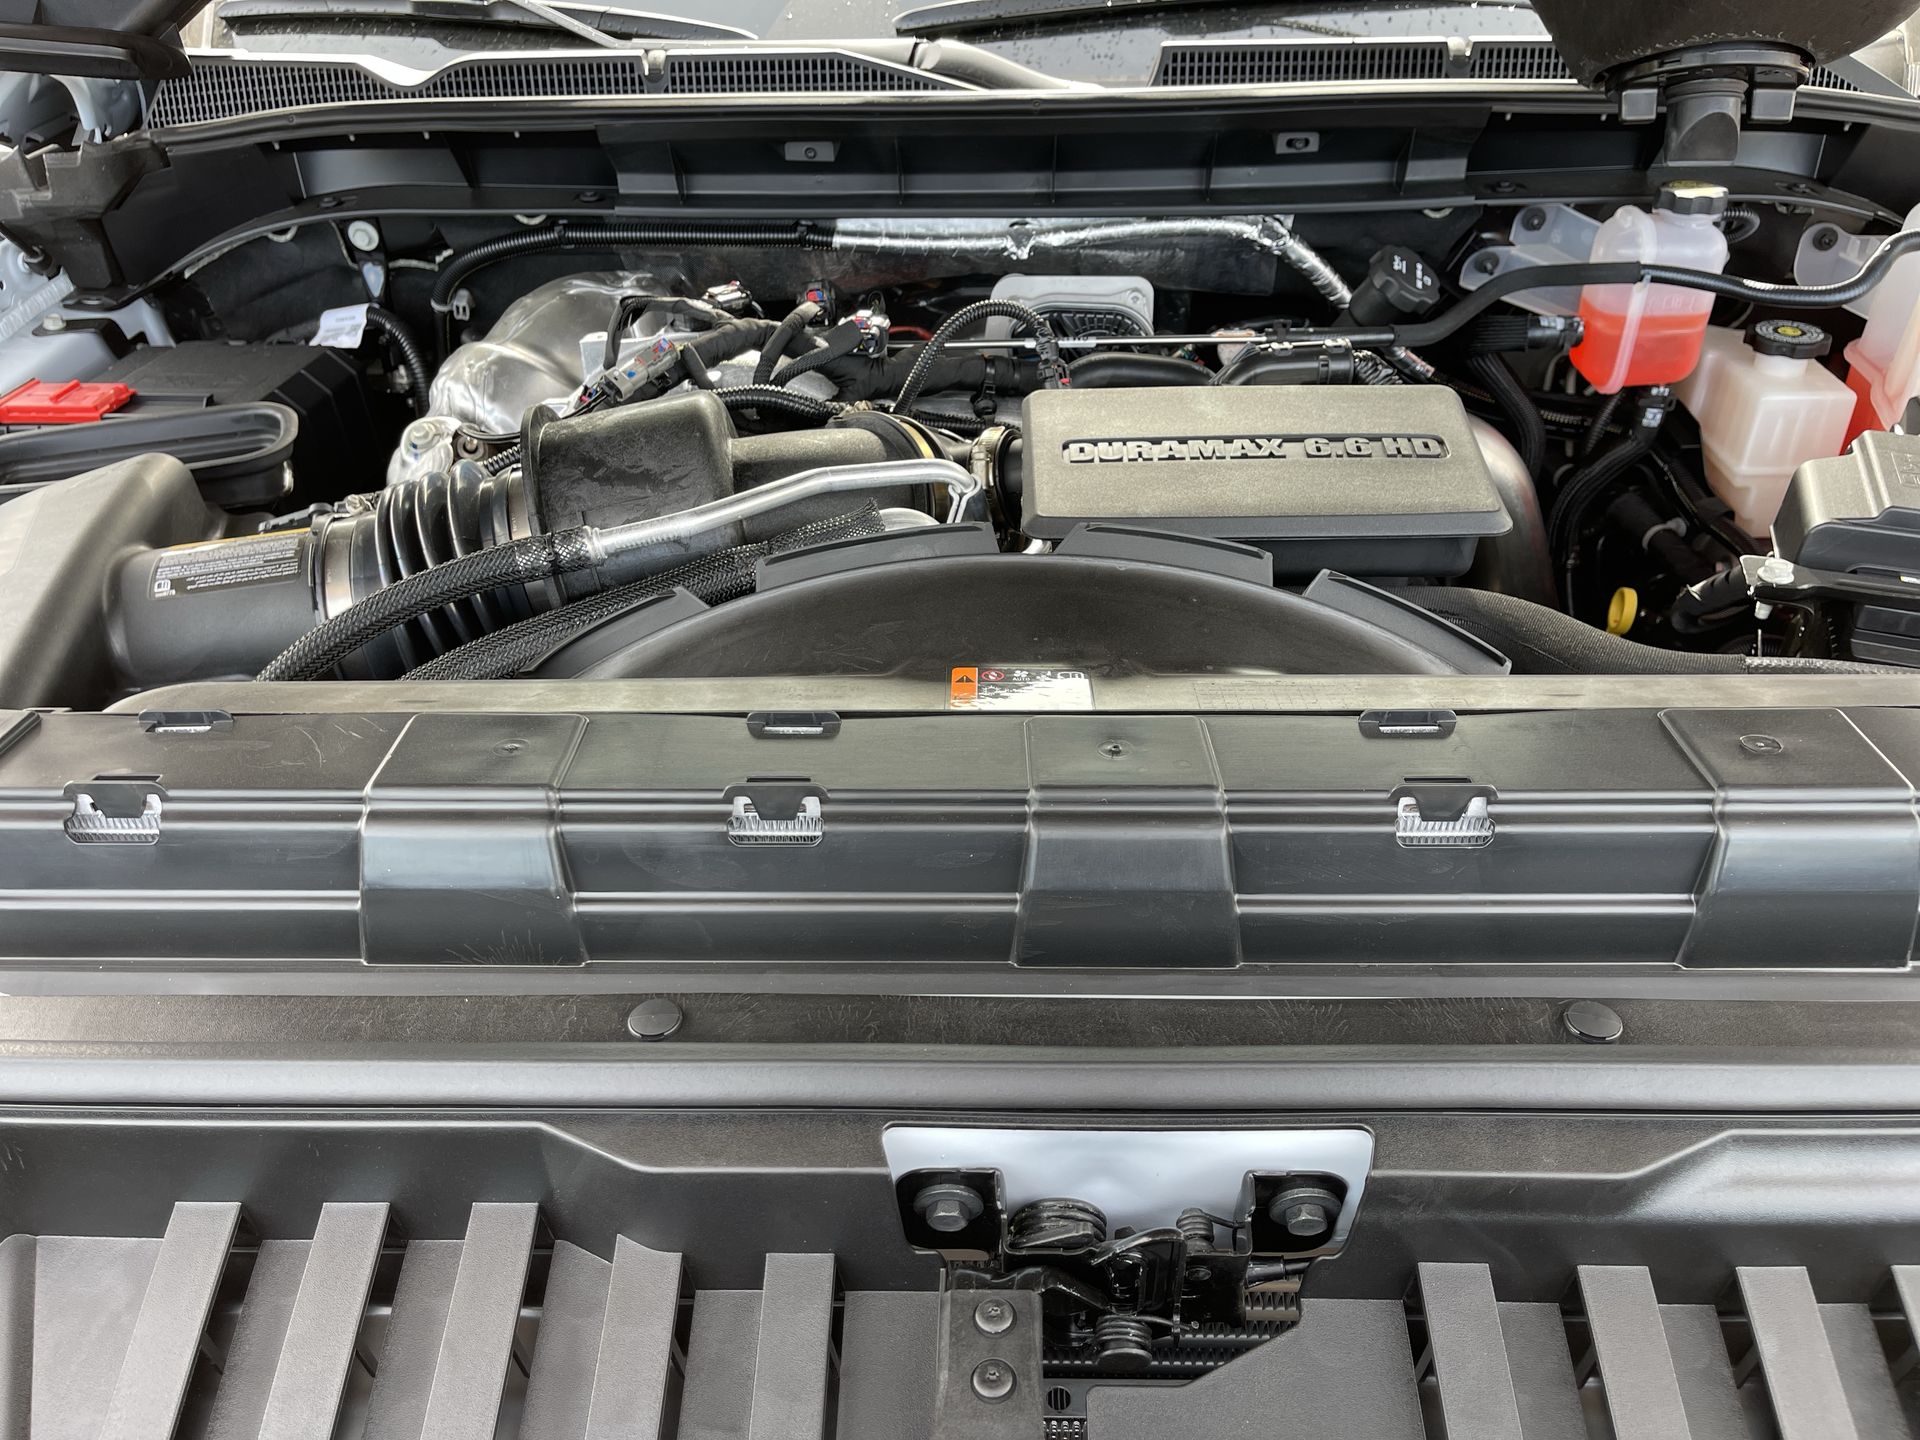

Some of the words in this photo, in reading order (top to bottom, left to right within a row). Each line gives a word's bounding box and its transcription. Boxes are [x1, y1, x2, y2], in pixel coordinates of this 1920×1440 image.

[1068, 438, 1286, 463] DURAMAX
[1304, 437, 1373, 458] 6.6
[1382, 435, 1443, 458] HD
